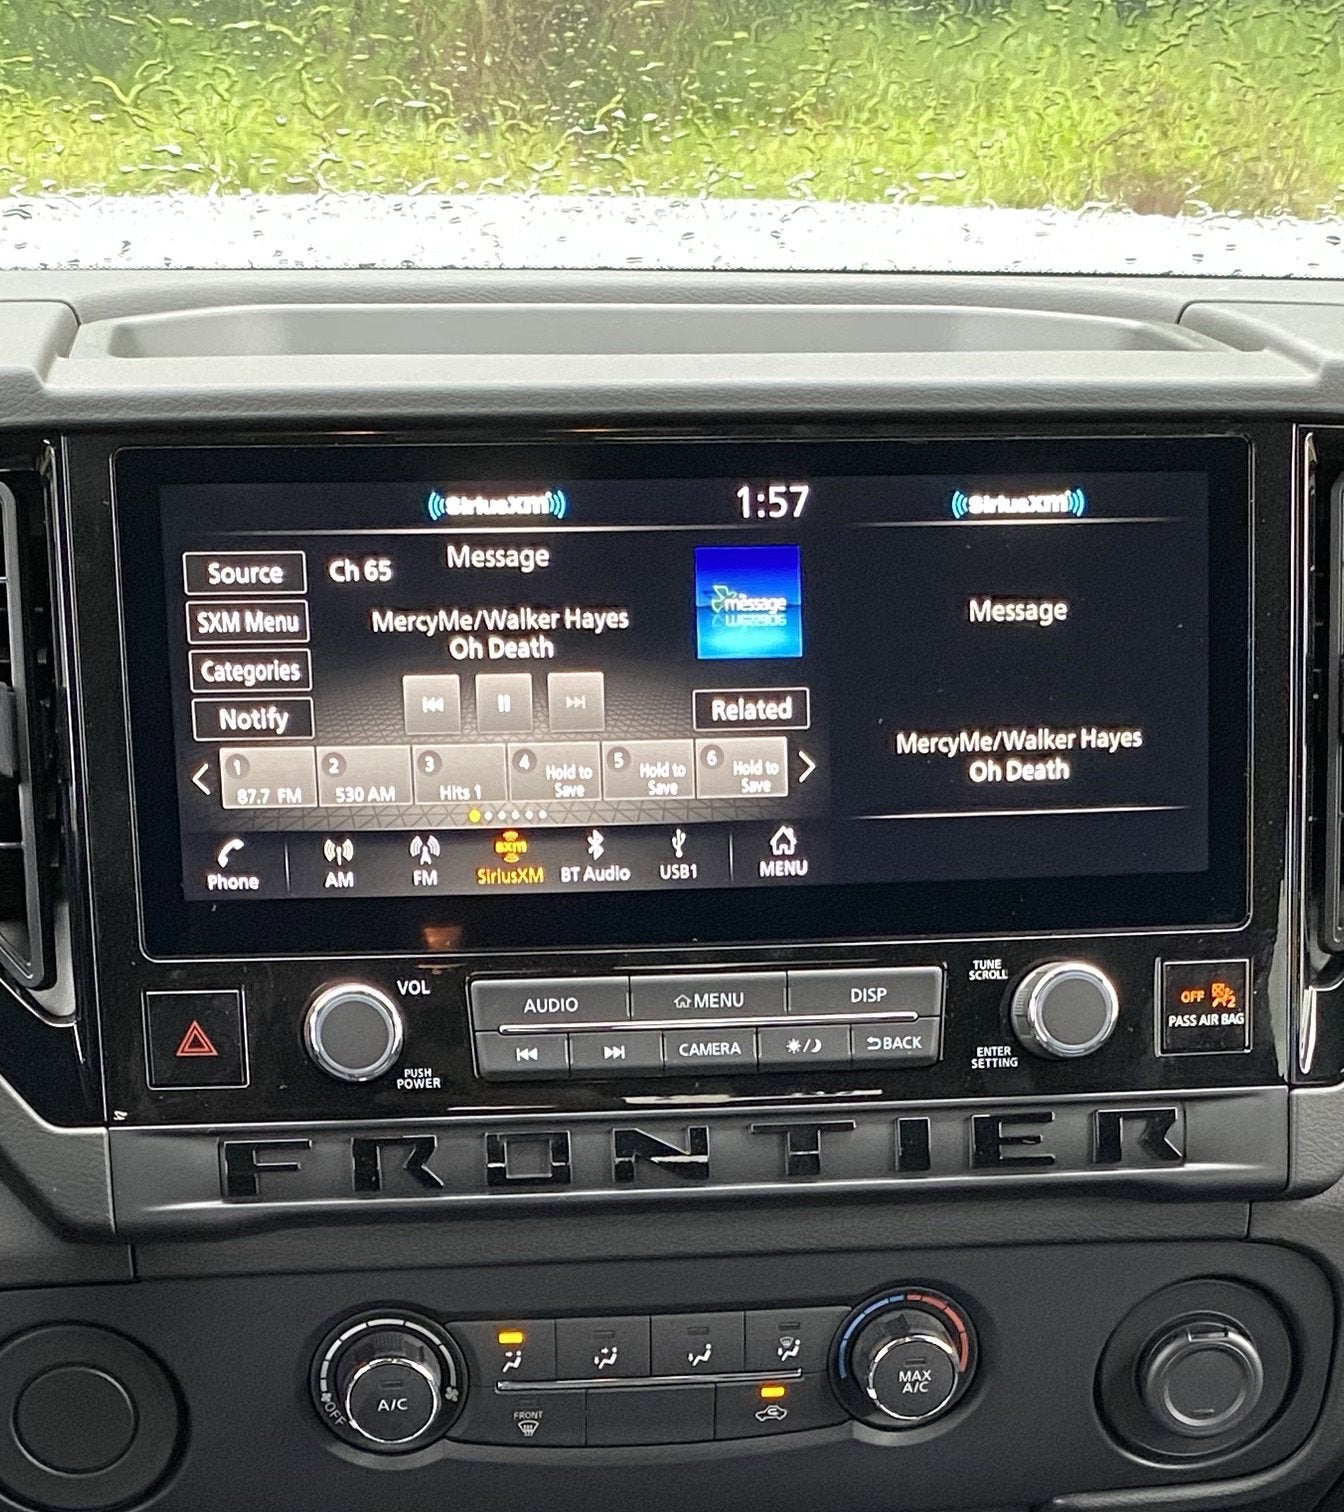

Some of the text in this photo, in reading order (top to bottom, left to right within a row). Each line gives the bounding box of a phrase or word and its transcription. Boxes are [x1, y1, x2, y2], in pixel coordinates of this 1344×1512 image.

[737, 485, 809, 519] 1:57
[447, 546, 549, 572] Message
[208, 562, 284, 585] Source
[329, 559, 392, 582] Ch 65
[969, 600, 1068, 626] Message
[197, 611, 299, 634] SXM Menu
[372, 607, 629, 637] MercyMe/Walker Hayes
[450, 635, 554, 660] Oh Death
[201, 659, 301, 686] Categories
[711, 696, 793, 721] Related
[219, 707, 288, 734] Notify
[896, 727, 1143, 757] MercyMe/Walker Hayes
[425, 757, 435, 772] 3
[519, 754, 530, 770] 4
[613, 753, 625, 768] 5
[706, 750, 718, 766] 6
[233, 760, 242, 775] 1
[329, 759, 339, 774] 2
[546, 764, 593, 780] Hold to
[639, 762, 686, 778] Hold to
[733, 760, 779, 776] Hold to
[969, 758, 1070, 782] Oh Death
[237, 788, 302, 804] 87.7 FM
[336, 786, 396, 802] 530 AM
[439, 784, 482, 800] Hits 1
[648, 780, 678, 796] Save
[477, 867, 544, 885] SiriusXM
[561, 865, 631, 882] BT Audio
[659, 864, 697, 880] USB1
[759, 860, 808, 877] MENU
[207, 873, 259, 891] Phone
[325, 871, 354, 888] AM
[413, 869, 438, 886] FM
[972, 960, 1003, 971] TUNE
[968, 968, 1009, 980] SCROLL
[397, 980, 431, 996] VOL
[851, 987, 888, 1004] DISP
[523, 997, 579, 1014] AUDIO
[693, 991, 745, 1009] MENU
[1181, 990, 1205, 1005] OFF
[1168, 1012, 1245, 1028] PASS AIR BAG
[678, 1041, 742, 1057] CAMERA
[882, 1034, 923, 1050] BACK
[976, 1046, 1012, 1058] ENTER
[971, 1057, 1019, 1070] SETTING
[404, 1067, 432, 1080] PUSH
[396, 1077, 441, 1090] POWER
[220, 1108, 1186, 1203] FRONTIER
[898, 1370, 931, 1383] MAX
[902, 1381, 929, 1394] A/C
[377, 1398, 408, 1412] A/C
[323, 1401, 347, 1427] OFF
[513, 1410, 543, 1420] FRONT
